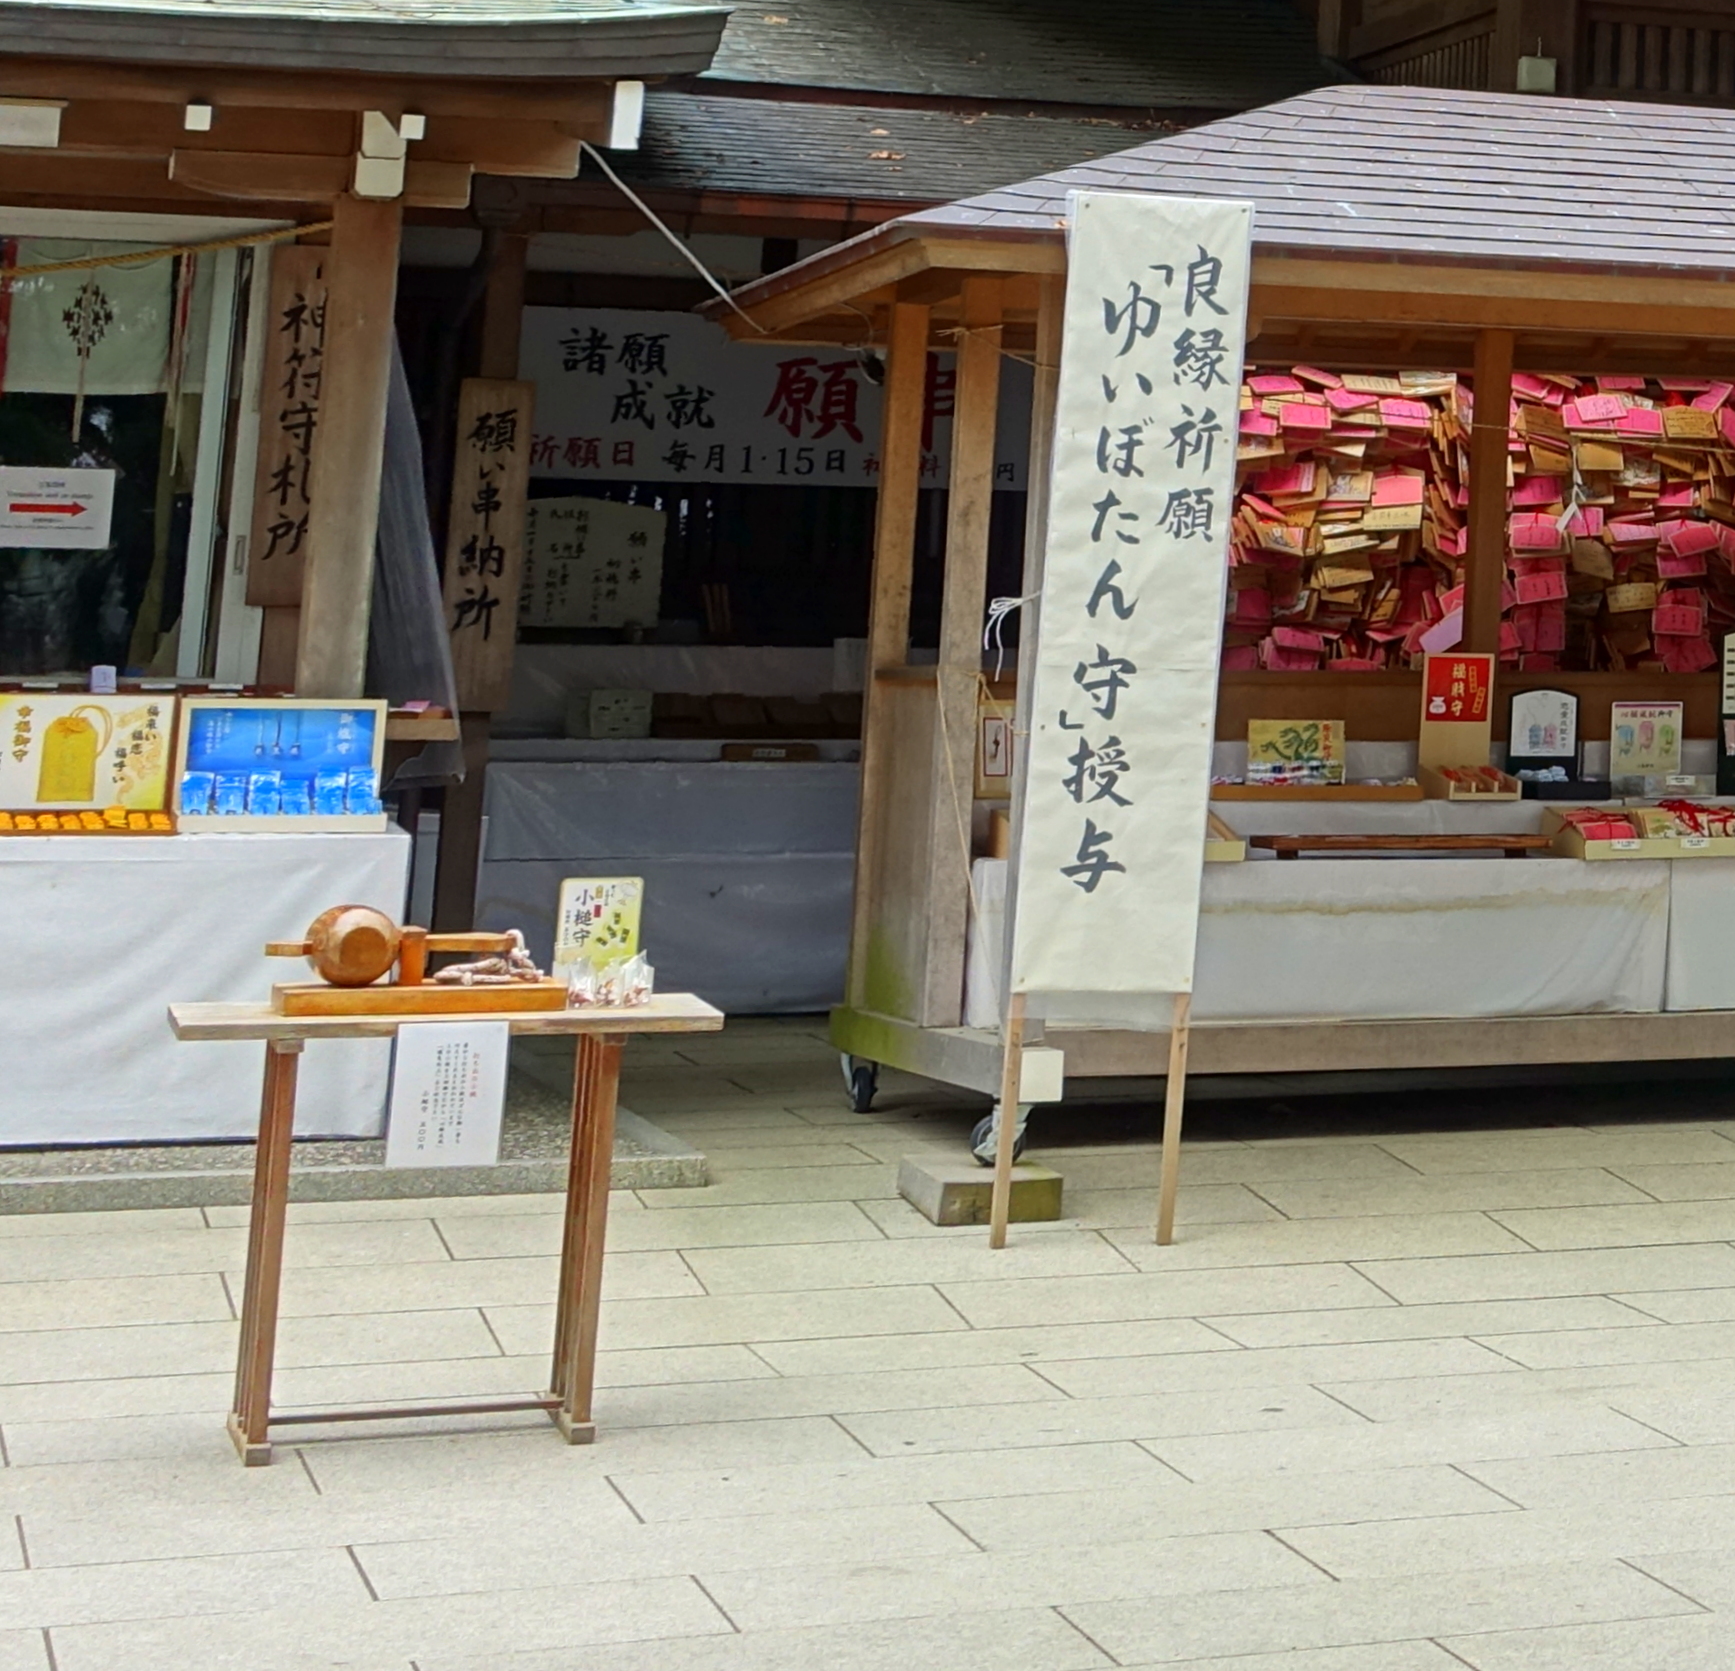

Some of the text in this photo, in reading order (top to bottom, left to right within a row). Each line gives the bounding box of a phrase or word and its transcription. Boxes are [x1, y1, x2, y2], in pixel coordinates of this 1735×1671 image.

[558, 326, 671, 378] 諸願
[610, 379, 716, 431] 成就
[1155, 243, 1231, 544] 良縁祈願
[527, 434, 636, 470] 祈願日
[453, 408, 518, 641] 願い串納所
[573, 888, 595, 948] 小槌守
